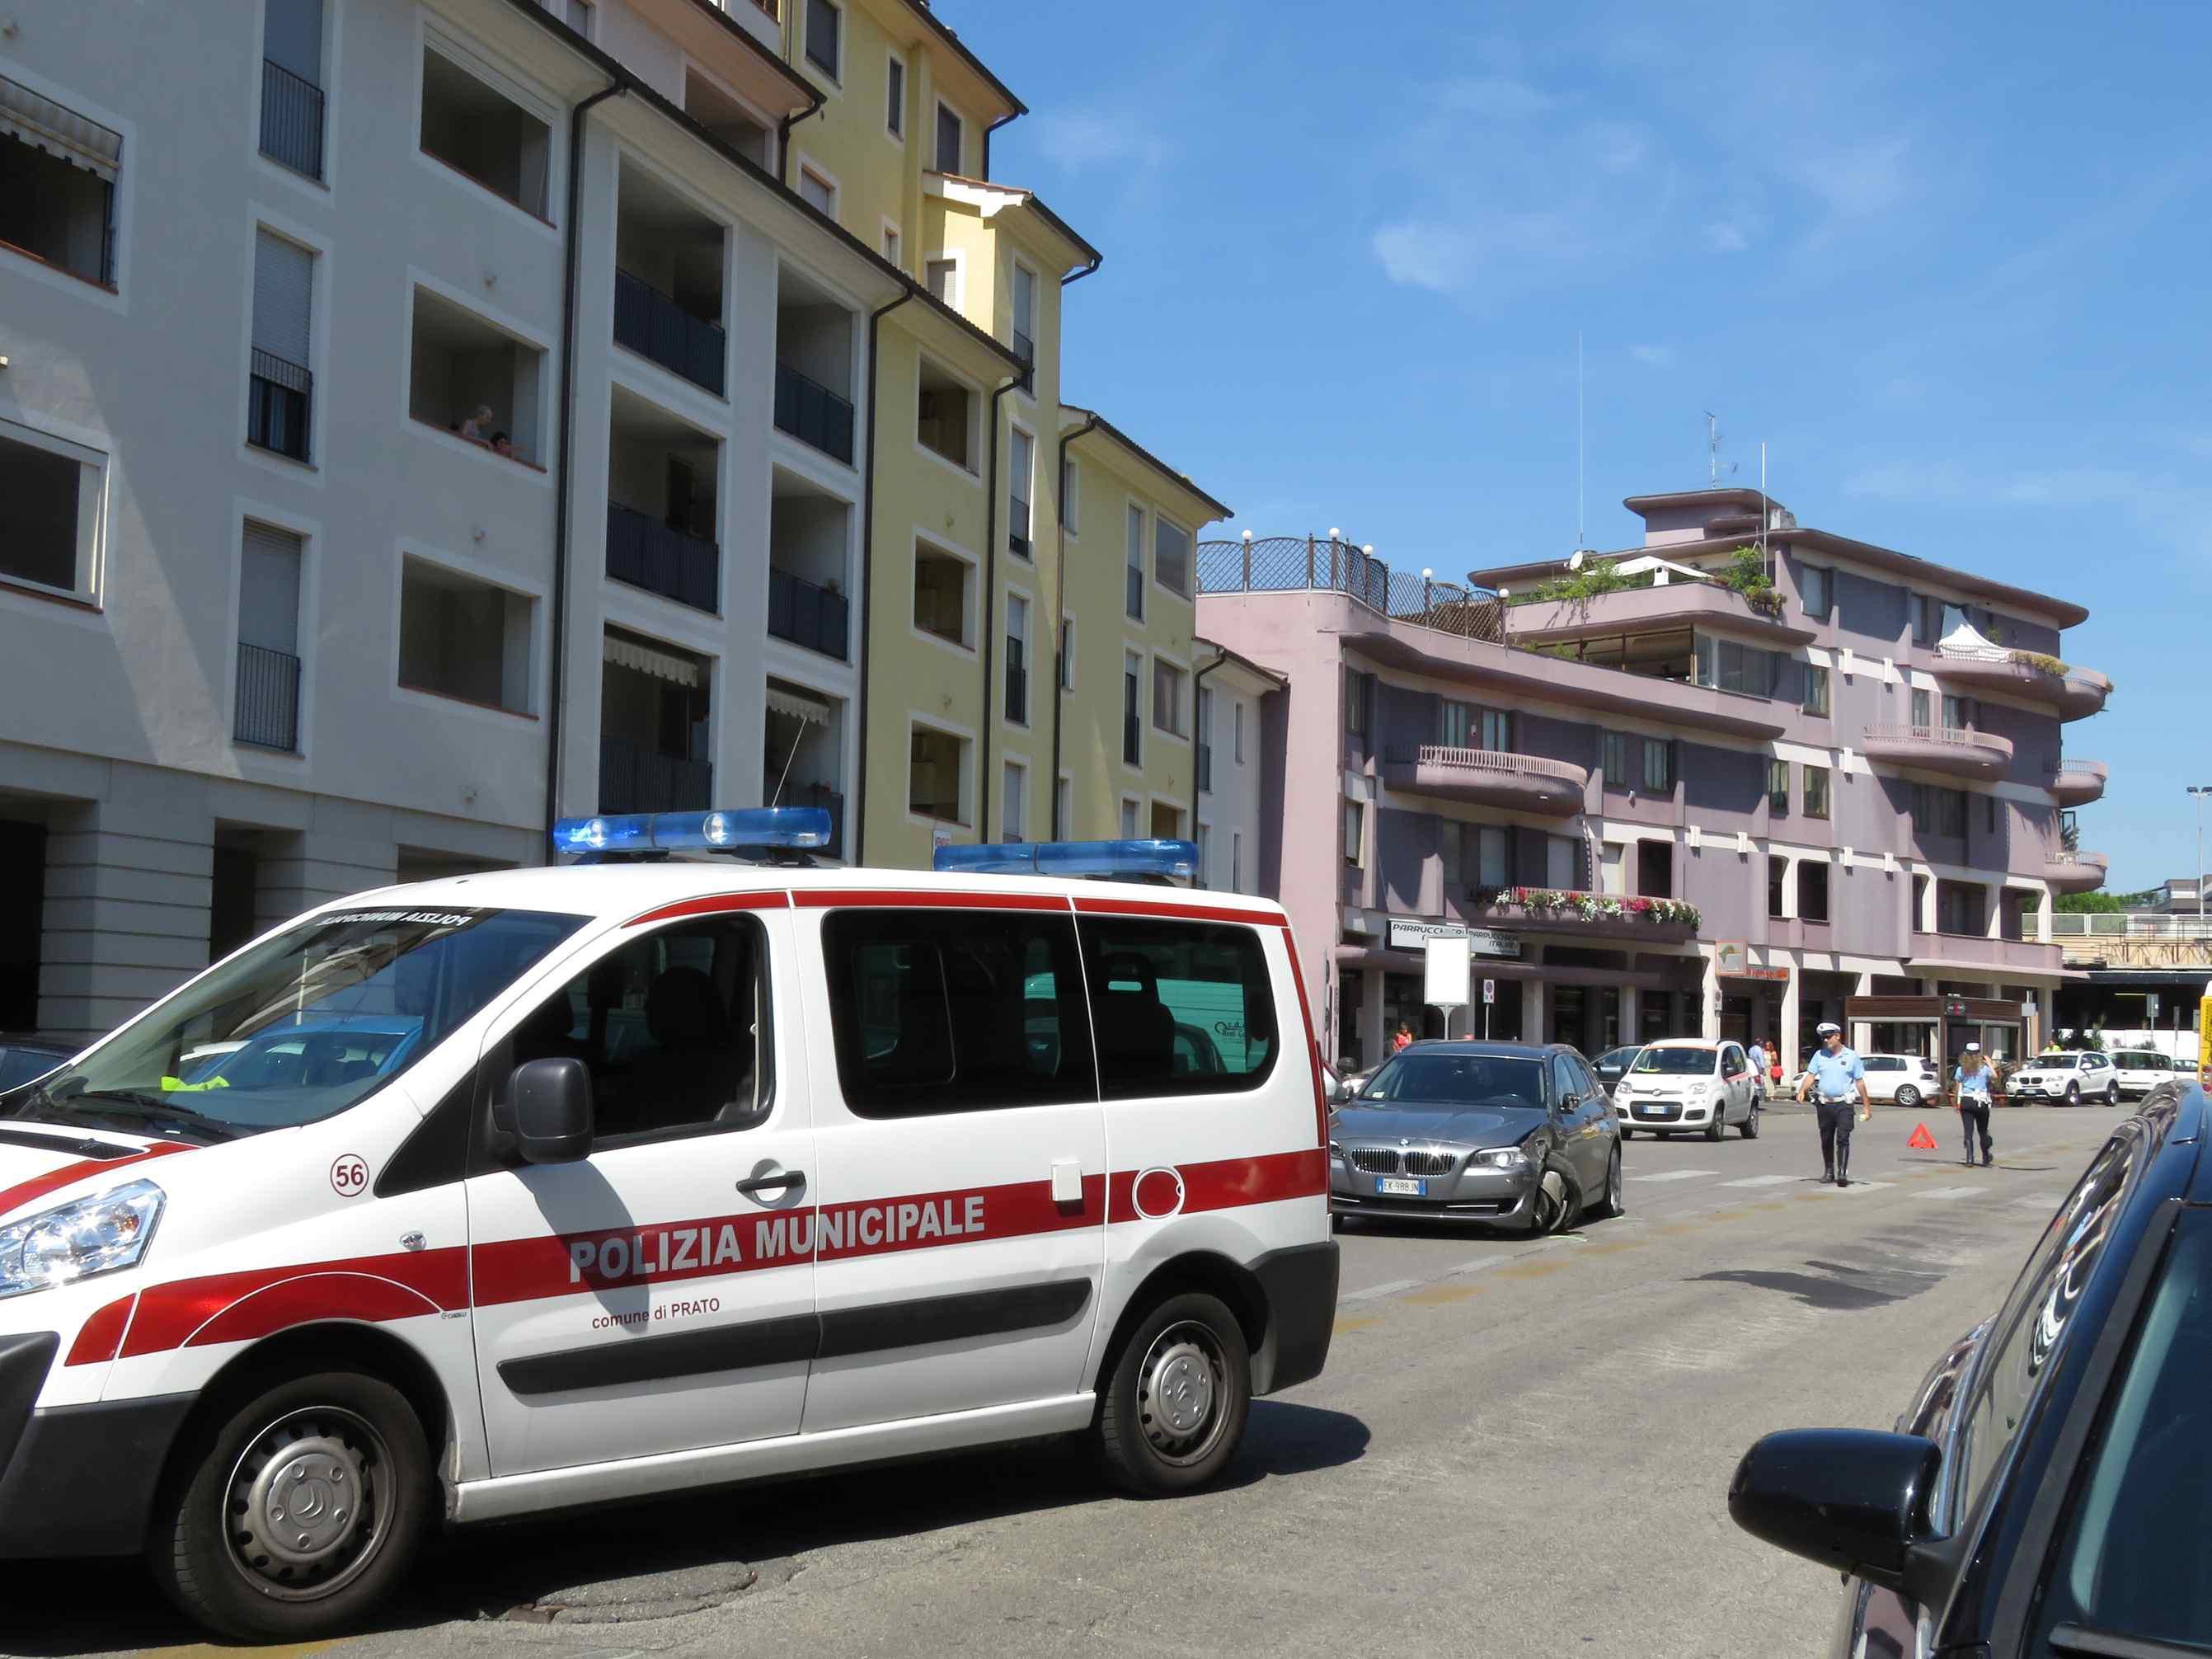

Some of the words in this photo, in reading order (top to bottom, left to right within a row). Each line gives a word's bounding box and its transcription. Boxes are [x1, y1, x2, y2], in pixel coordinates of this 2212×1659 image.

[336, 1163, 364, 1187] 56
[570, 1224, 742, 1283] POLIZIA
[756, 1196, 985, 1259] MUNICIPALE
[592, 1310, 650, 1329] comune
[655, 1305, 666, 1320] di
[671, 1298, 720, 1317] PRATO
